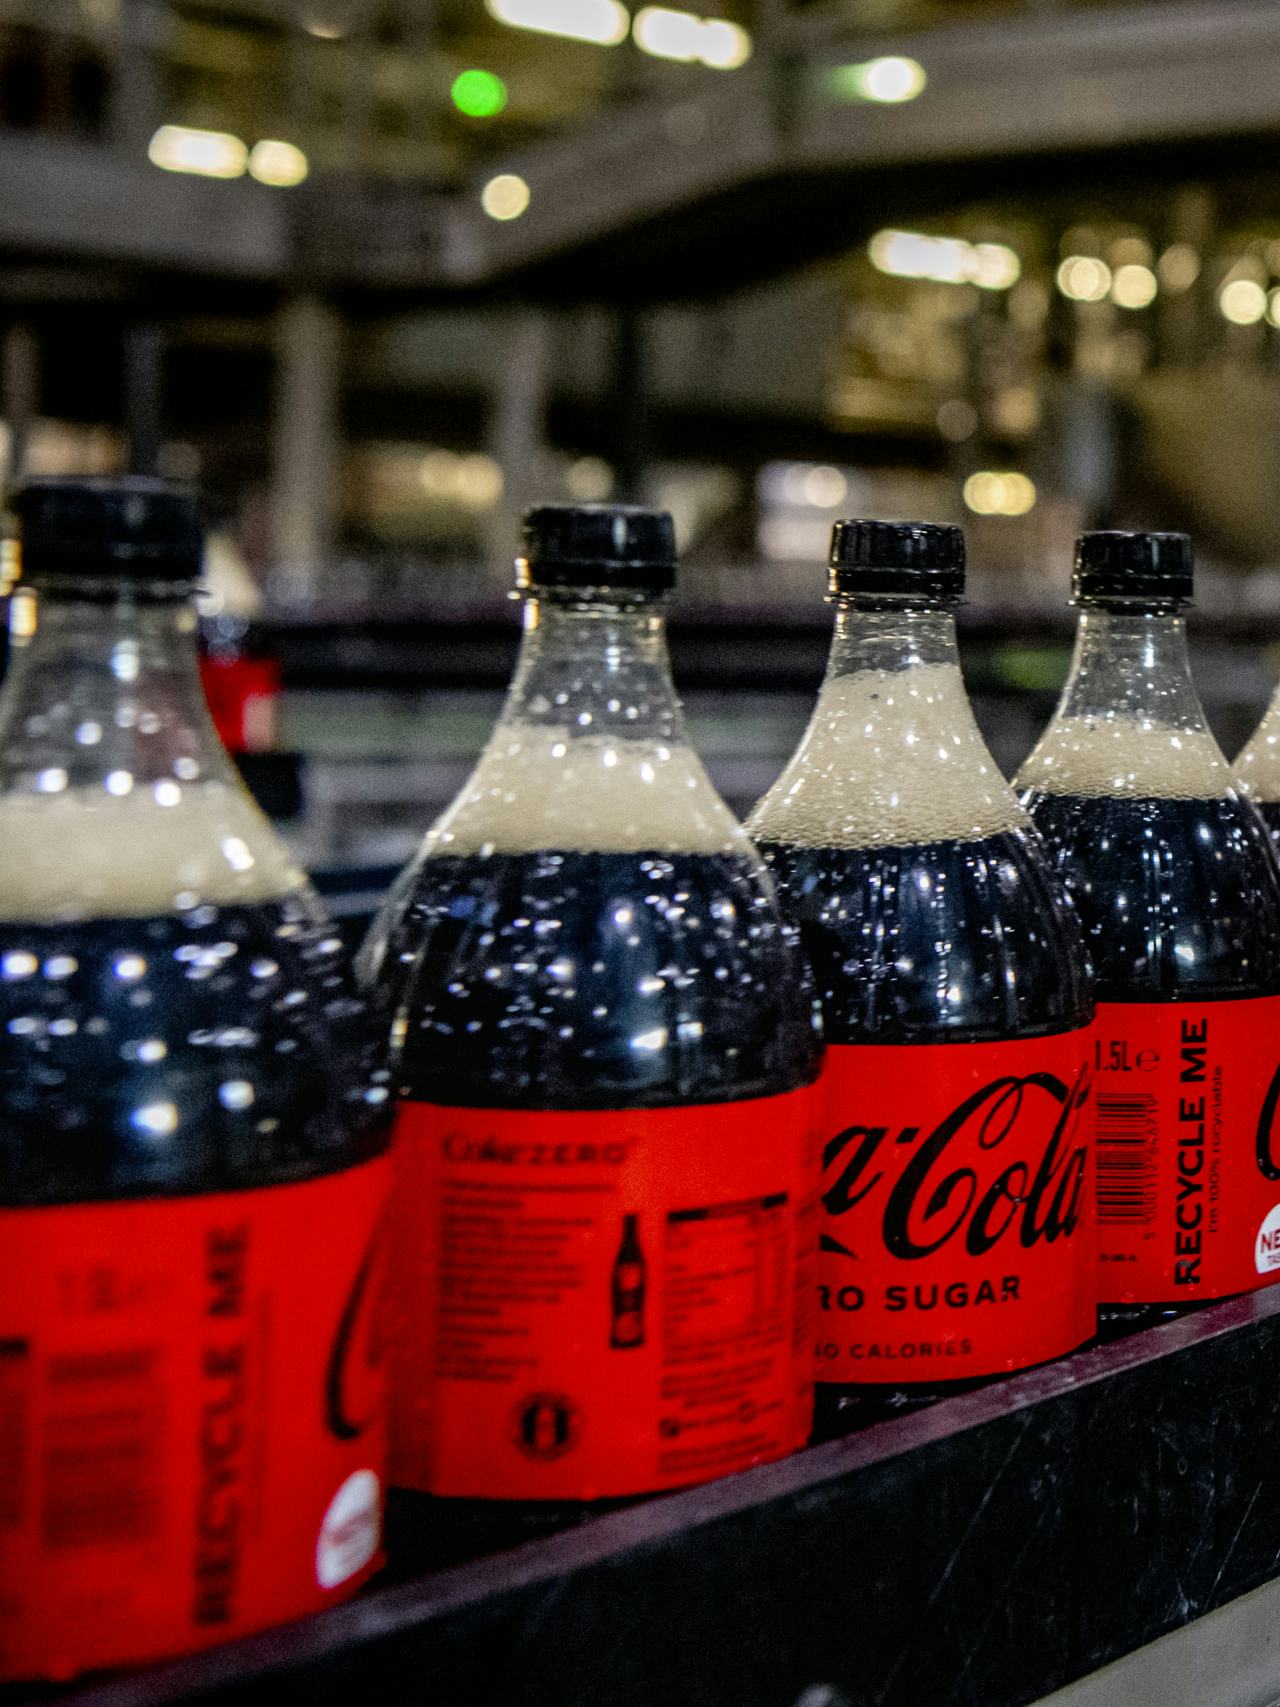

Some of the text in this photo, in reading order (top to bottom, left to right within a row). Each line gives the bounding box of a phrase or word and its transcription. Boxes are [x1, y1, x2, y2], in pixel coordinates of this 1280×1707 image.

[1095, 1040, 1131, 1072] 1.5L
[1174, 1018, 1208, 1285] RECYCLE ME
[884, 1275, 1021, 1312] SUGAR
[849, 1338, 974, 1361] CALORIES
